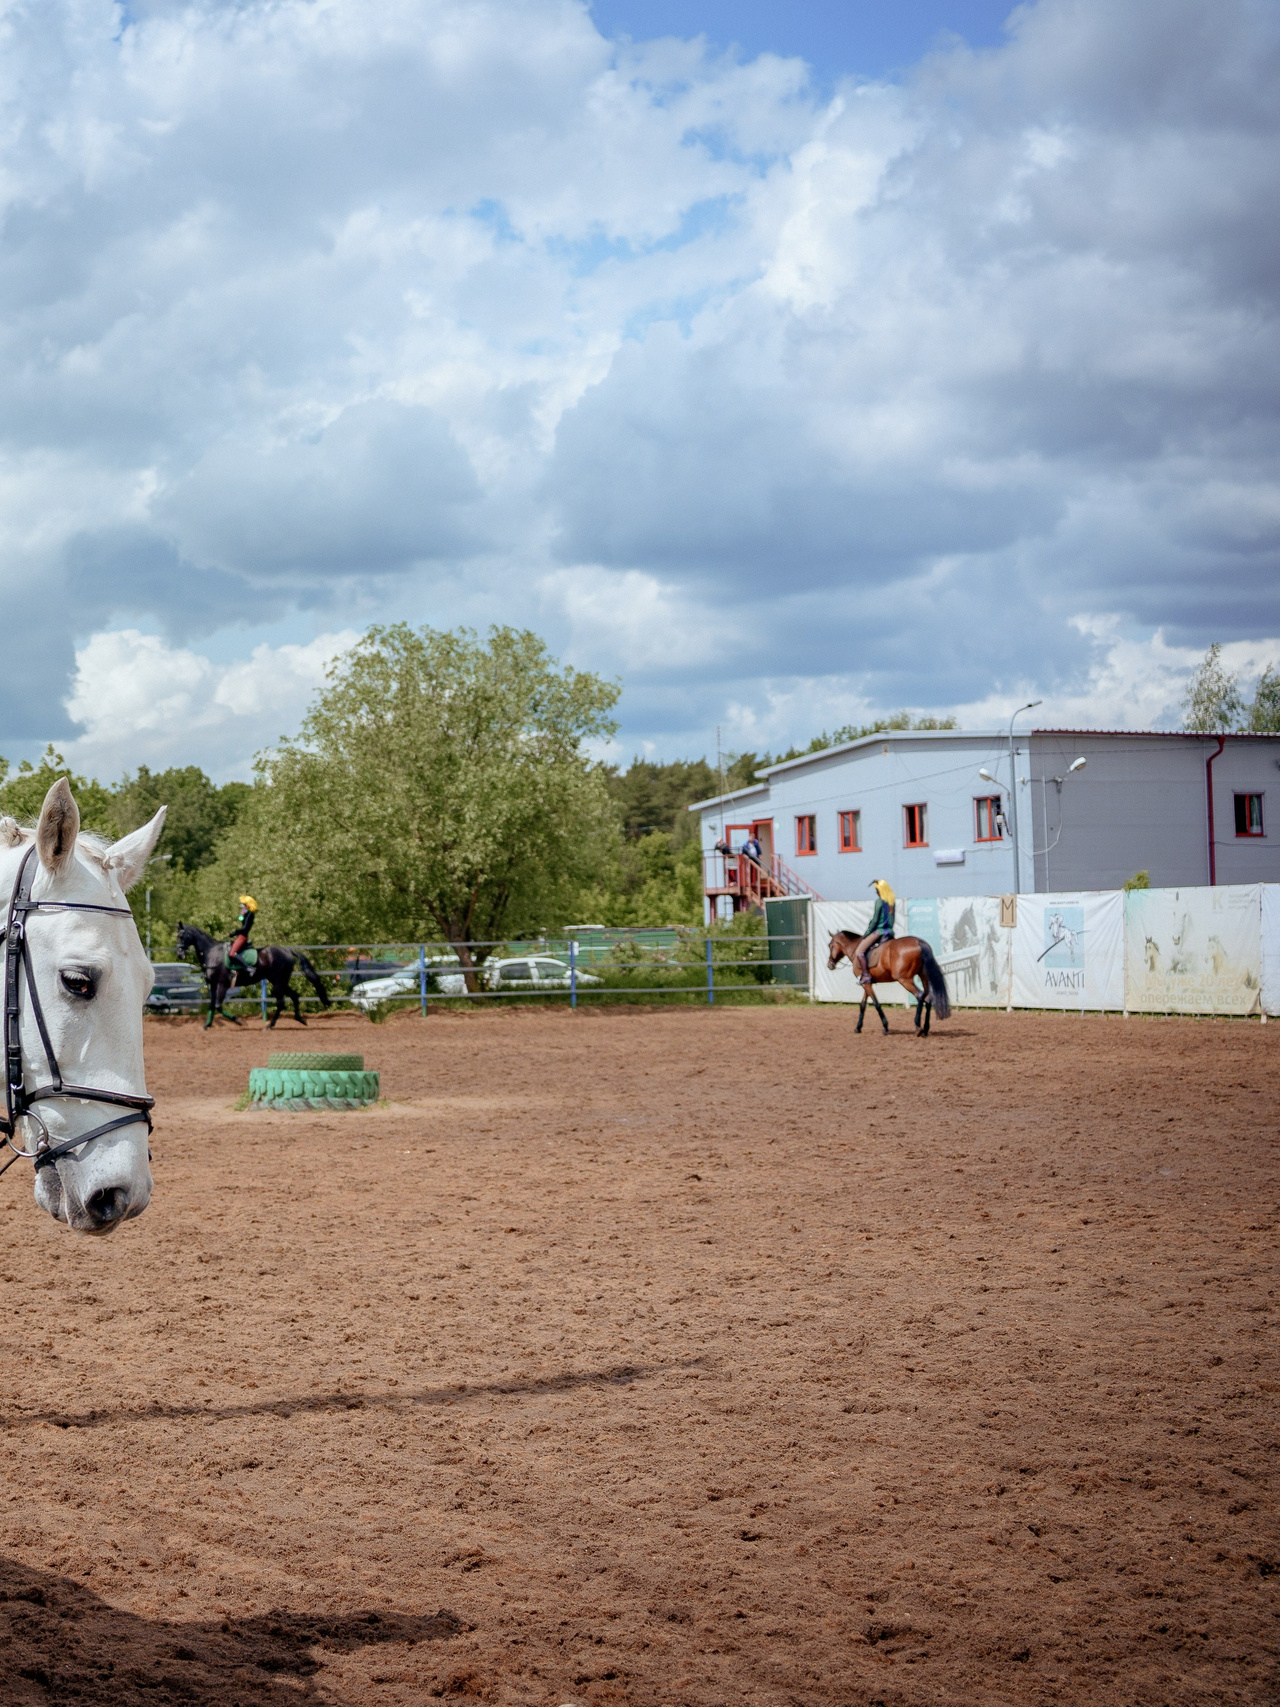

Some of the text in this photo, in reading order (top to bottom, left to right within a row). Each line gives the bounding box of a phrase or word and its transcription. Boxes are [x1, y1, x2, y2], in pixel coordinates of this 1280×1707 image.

[1001, 898, 1014, 922] M
[1044, 969, 1085, 989] AVANTI
[1140, 993, 1246, 1006] опережаем всех
